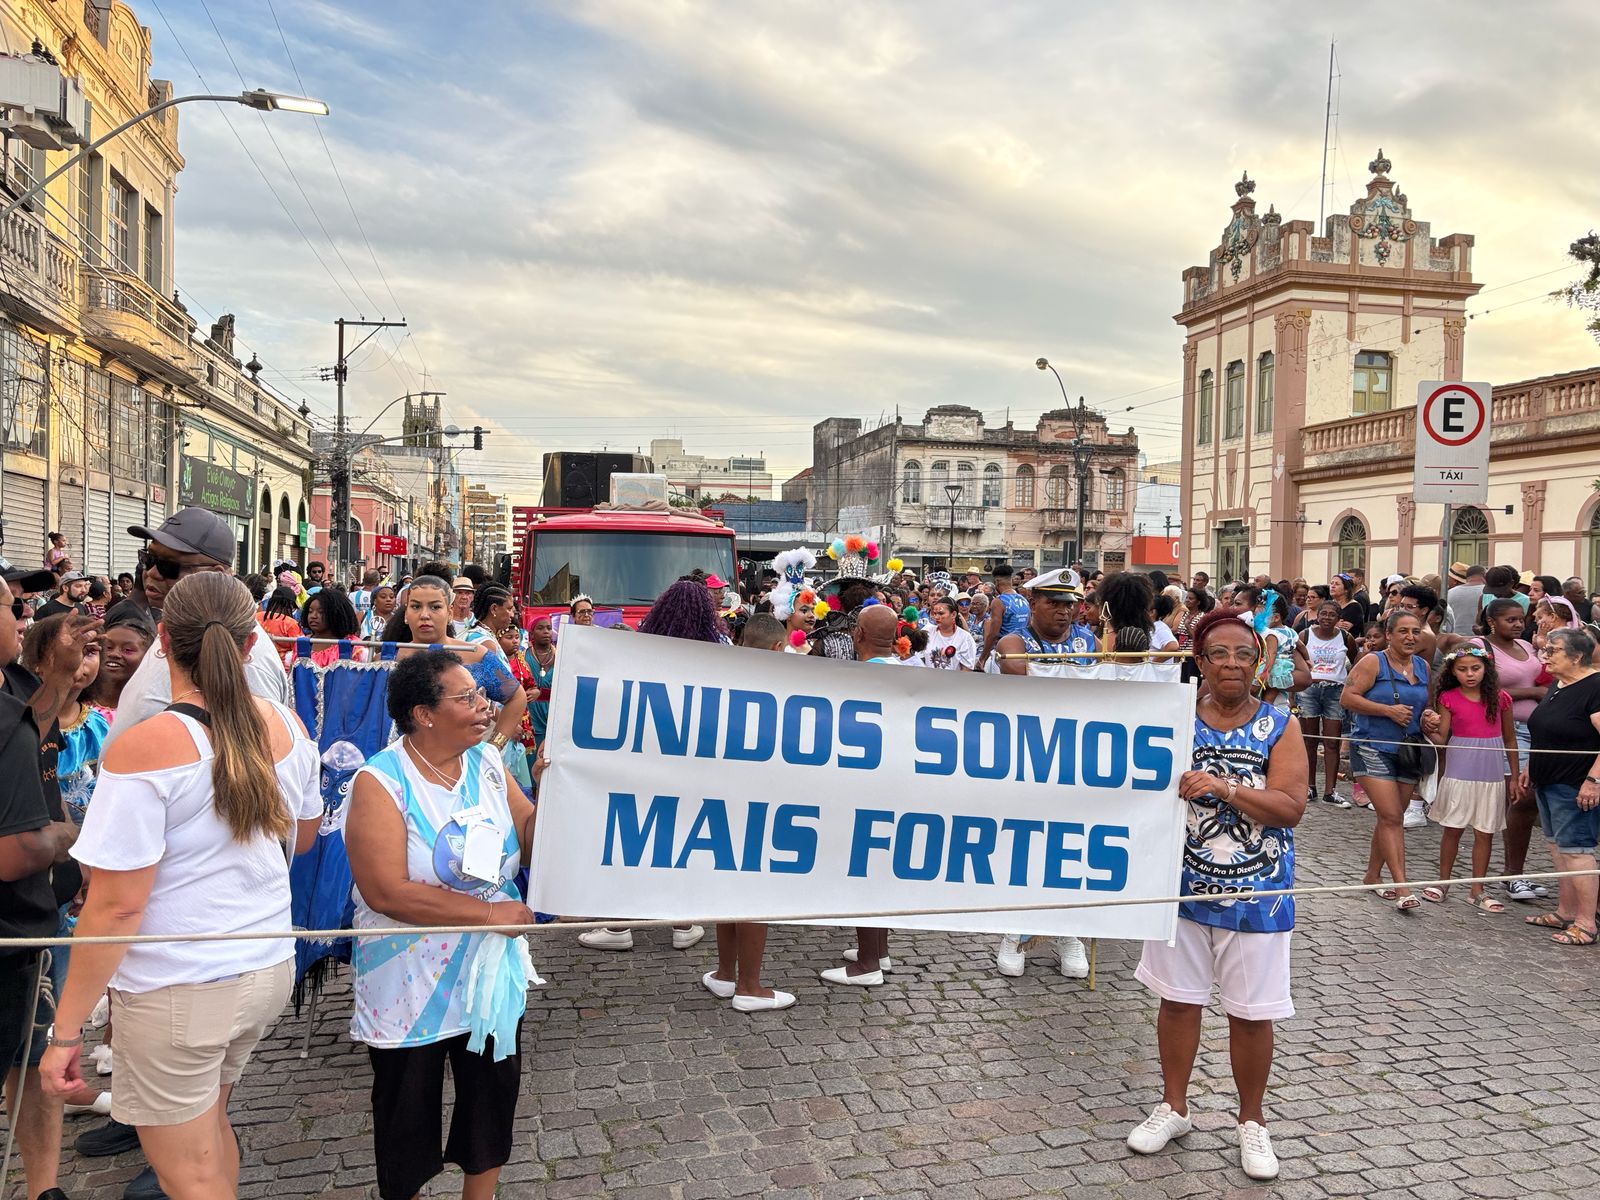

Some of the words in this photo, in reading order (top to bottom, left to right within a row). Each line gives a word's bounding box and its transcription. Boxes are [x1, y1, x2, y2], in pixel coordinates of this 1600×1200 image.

[1443, 398, 1465, 432] E
[1440, 469, 1463, 480] TÁXI
[201, 486, 219, 507] Artigos
[572, 676, 882, 769] UNIDOS
[915, 707, 1174, 790] SOMOS
[602, 793, 819, 873] MAIS
[848, 809, 1129, 891] FORTES
[1184, 854, 1197, 866] Fica
[1237, 862, 1264, 874] Dizendo
[1192, 881, 1255, 902] 2025
